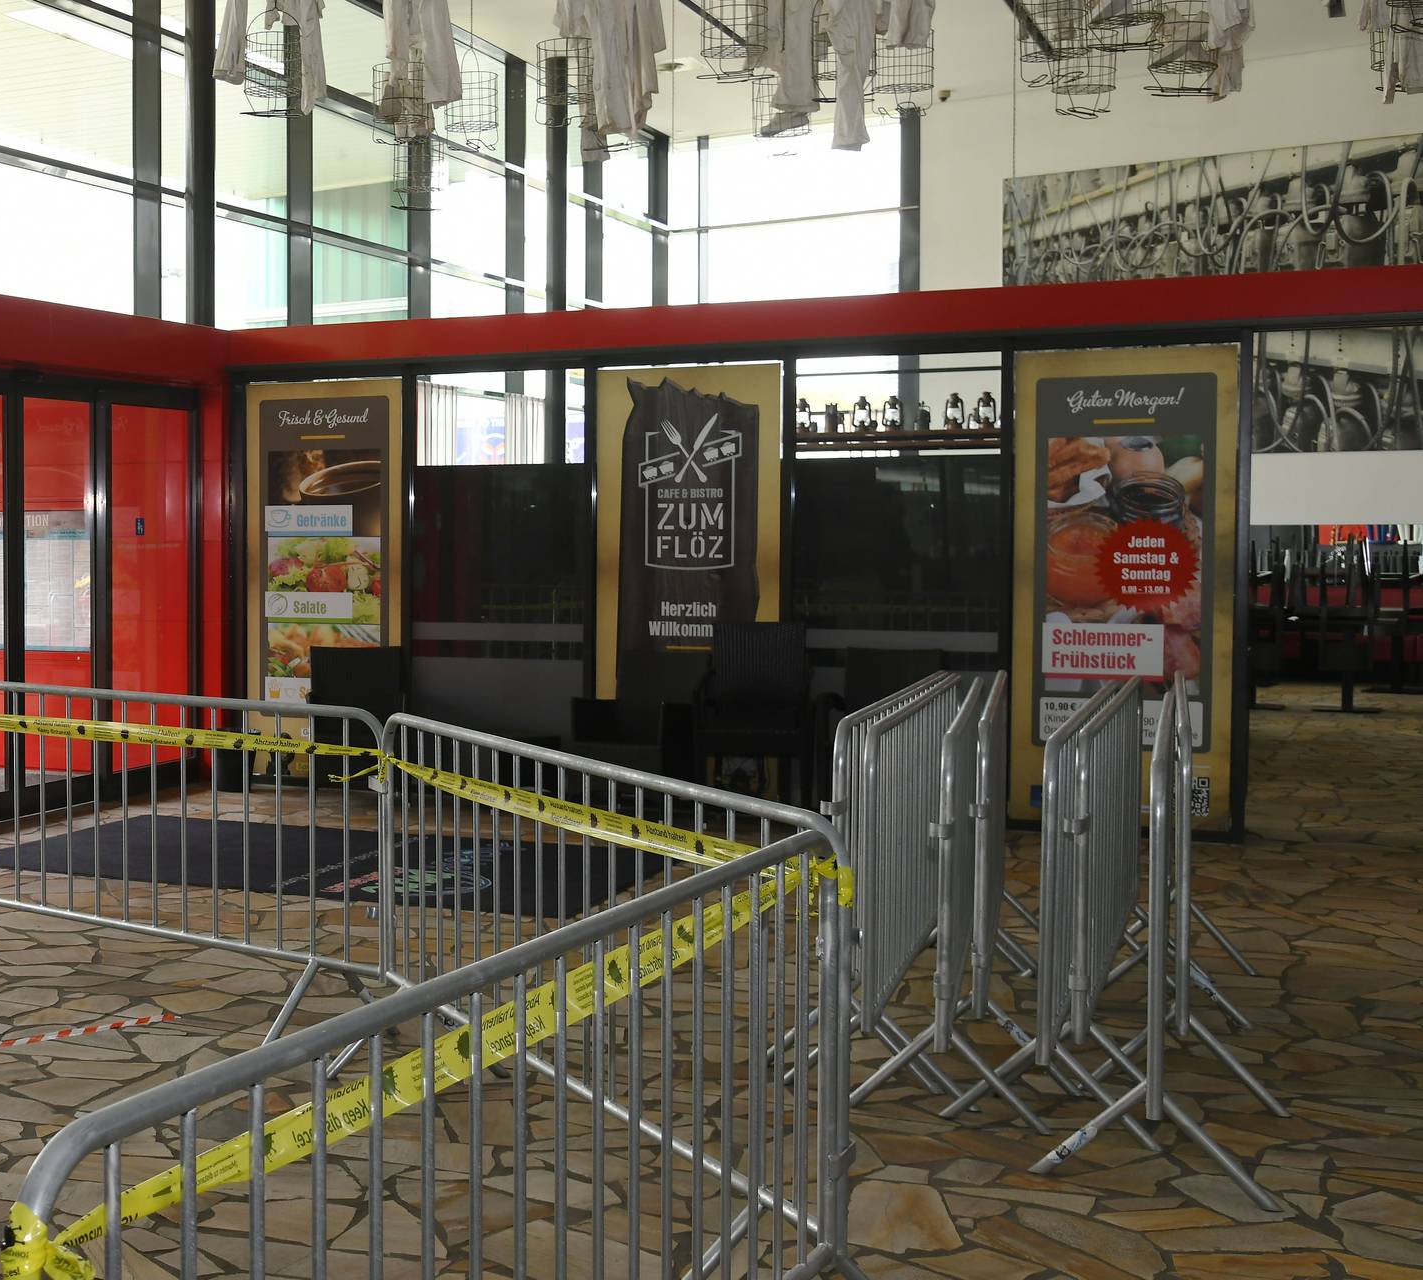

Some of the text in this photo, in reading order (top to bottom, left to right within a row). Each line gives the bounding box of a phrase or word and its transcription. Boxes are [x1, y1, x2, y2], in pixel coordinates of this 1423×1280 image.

[1067, 387, 1185, 414] Guten Morgen!
[278, 408, 369, 429] Frisch & Gesund
[681, 488, 688, 498] &
[690, 488, 723, 499] BISTRO
[296, 514, 347, 528] Getränke
[656, 502, 724, 530] ZUM
[656, 531, 724, 559] FLÖZ
[1127, 535, 1166, 548] Jeden
[1113, 551, 1179, 566] Samstag &
[1121, 567, 1171, 582] Sonntag
[293, 600, 327, 615] Salate
[661, 601, 717, 617] Herzlich
[649, 621, 714, 637] Willkomm
[1052, 628, 1154, 647] Schlemmer-
[1052, 650, 1137, 670] Frühstück
[1044, 702, 1077, 711] 10,90 €
